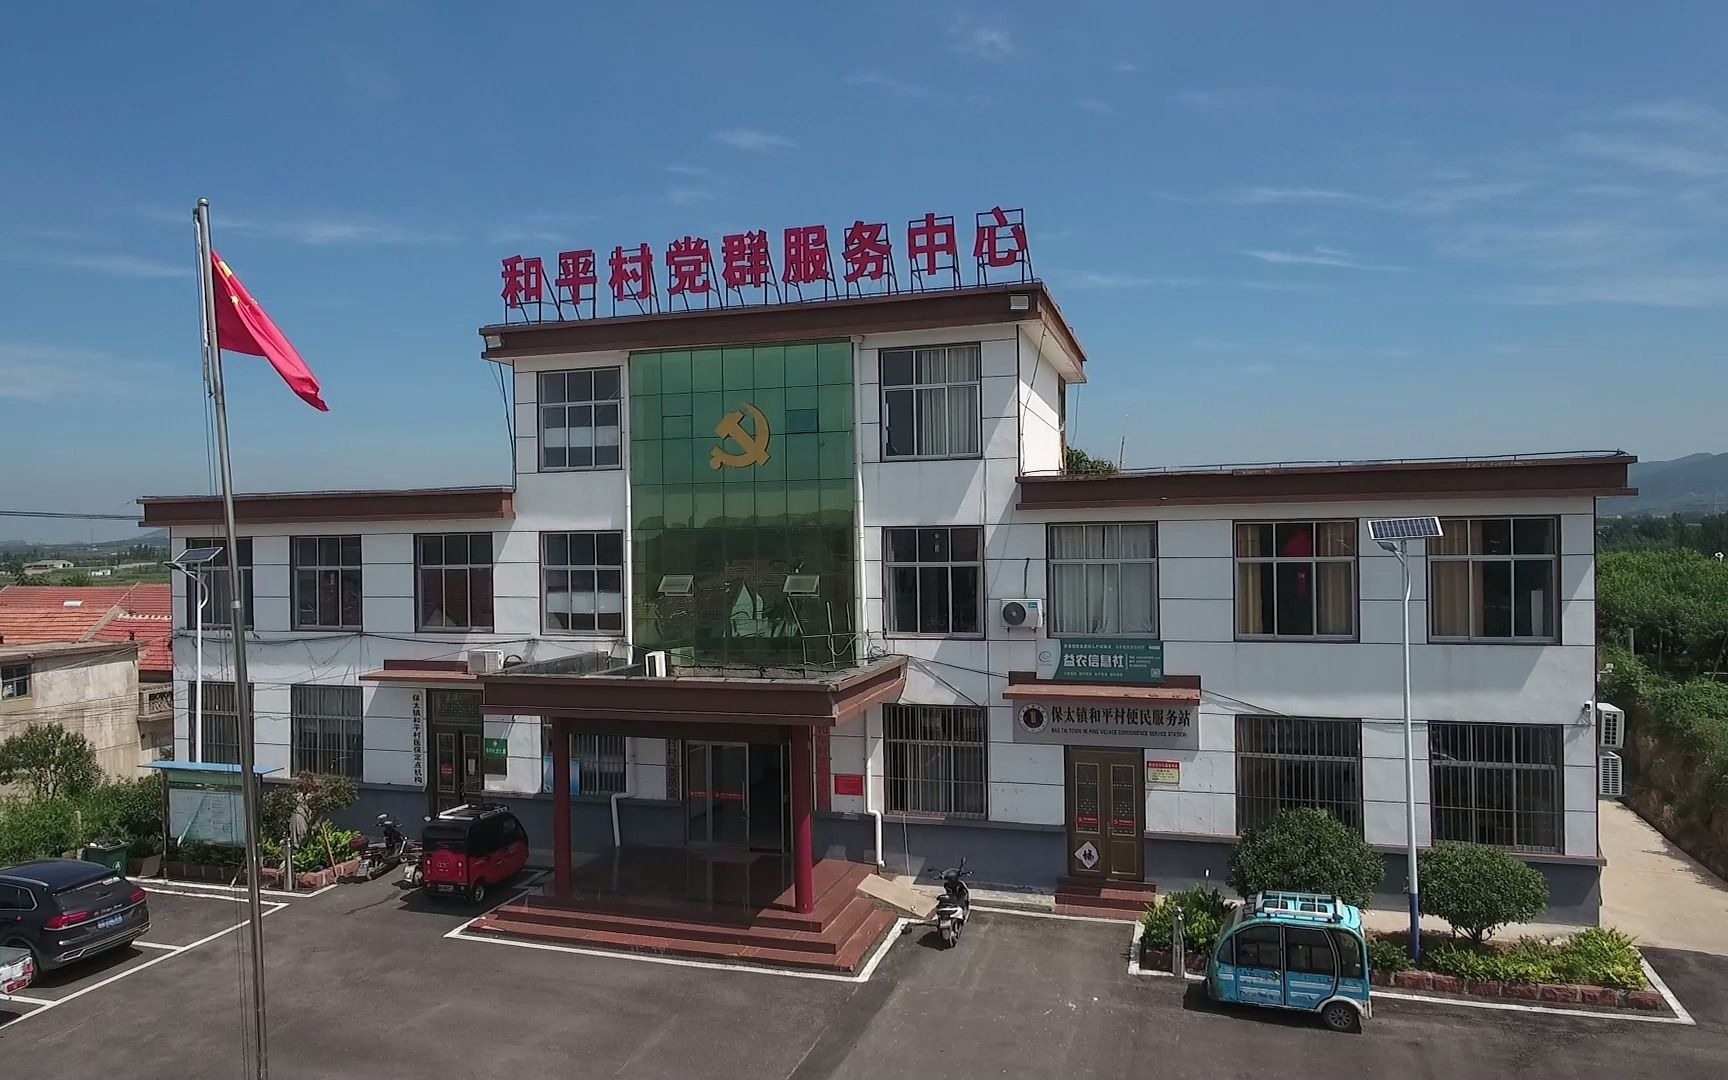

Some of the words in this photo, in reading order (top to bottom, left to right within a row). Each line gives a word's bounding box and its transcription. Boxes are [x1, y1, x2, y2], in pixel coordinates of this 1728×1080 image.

[502, 206, 1026, 309] 和平村党群服务中心
[1063, 653, 1124, 668] 益农信息社
[1051, 706, 1191, 727] 保太镇和平村便民服务站
